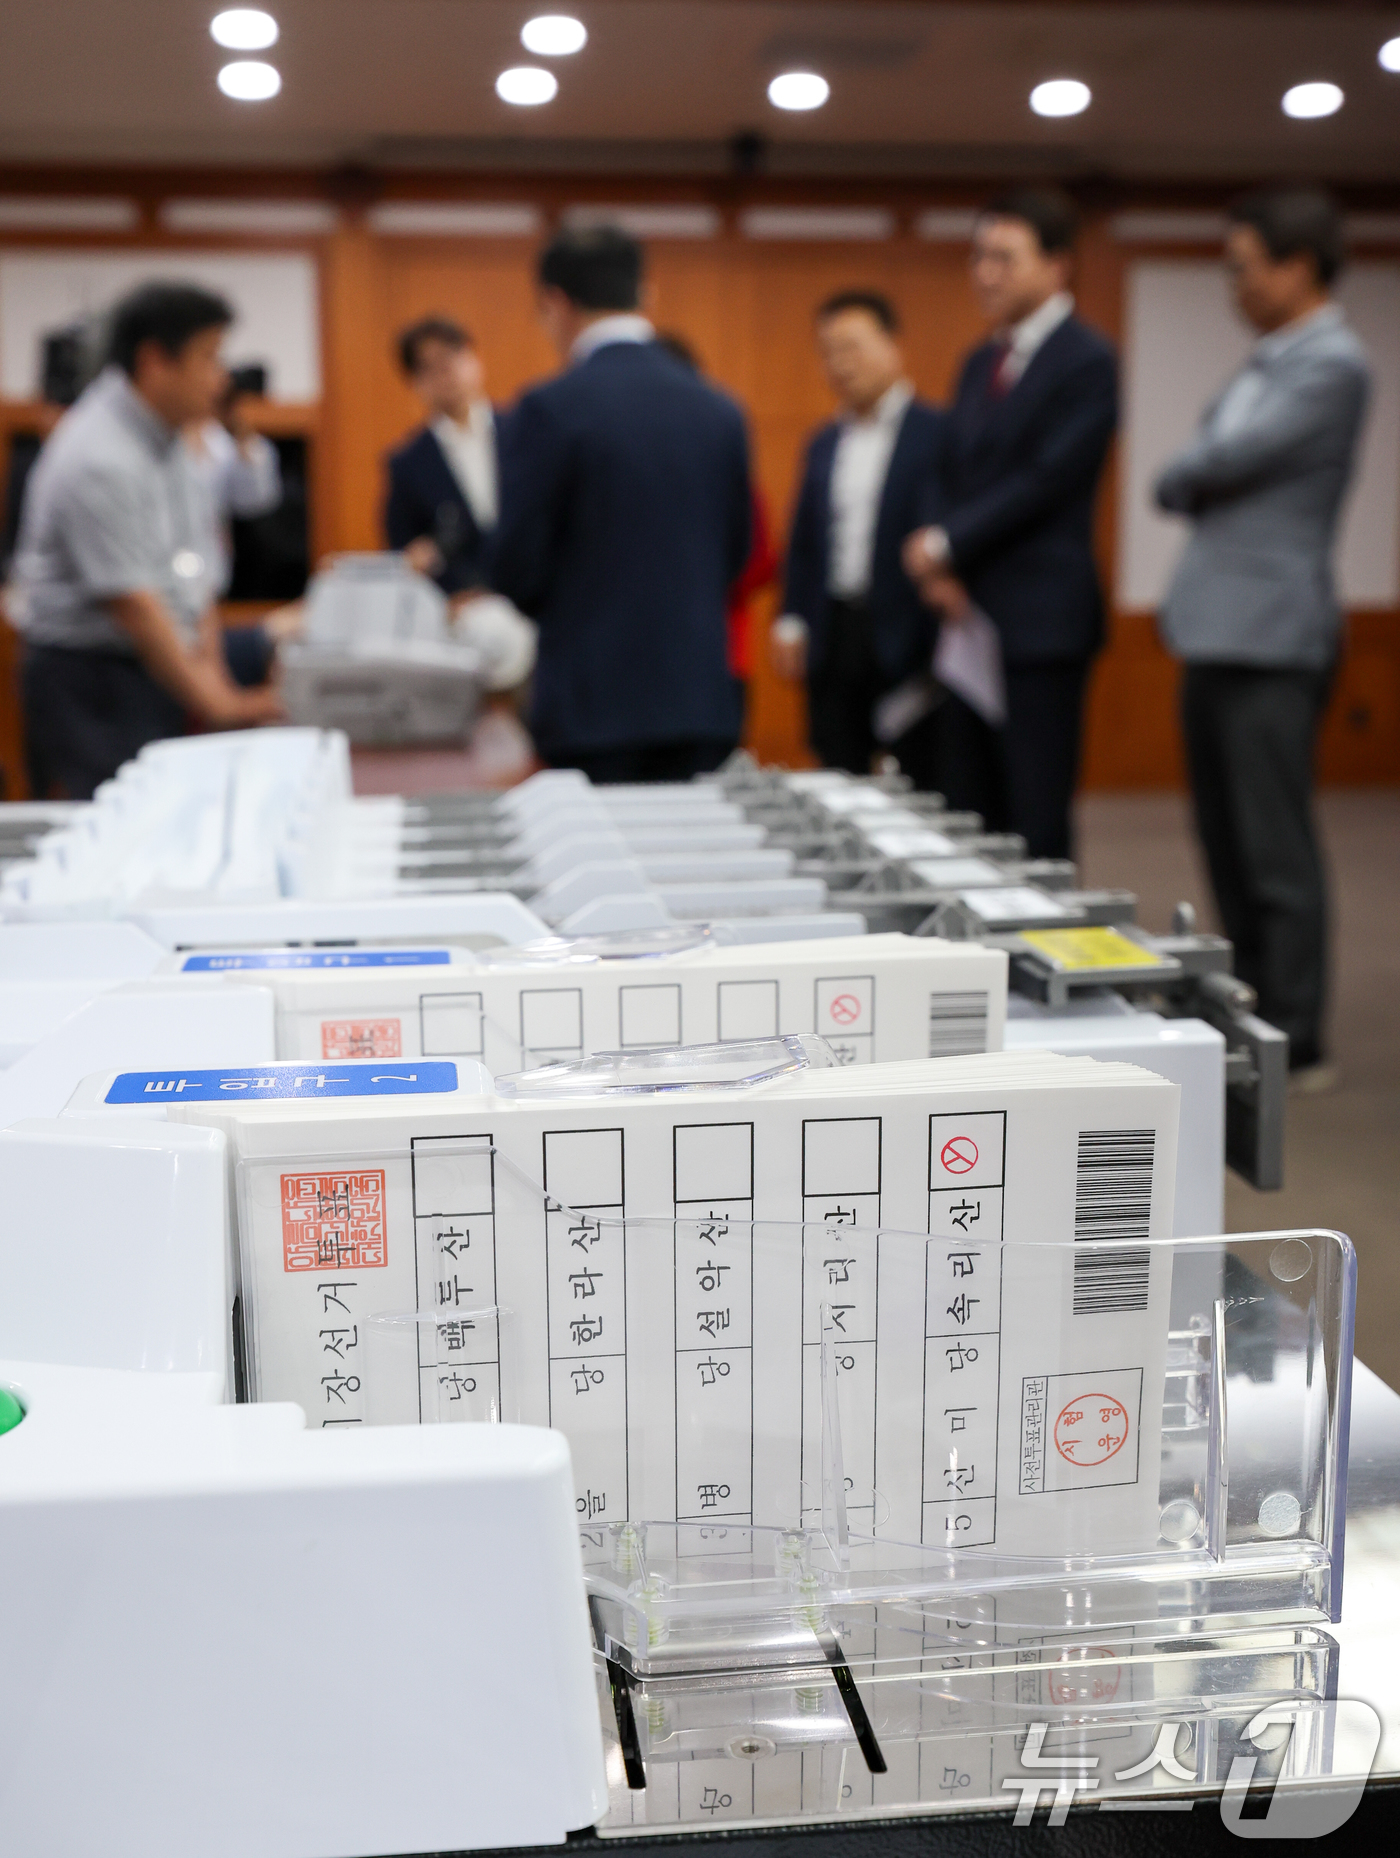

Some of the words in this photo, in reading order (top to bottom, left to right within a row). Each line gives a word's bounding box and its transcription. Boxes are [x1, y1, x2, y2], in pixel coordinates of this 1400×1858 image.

[143, 1072, 350, 1094] 투입구
[370, 1073, 418, 1083] 2
[568, 1215, 604, 1346] 한라산
[696, 1210, 732, 1339] 설악산
[946, 1198, 982, 1326] 속리산
[1022, 1379, 1045, 1492] 사전투표관리관
[945, 1513, 973, 1533] 5
